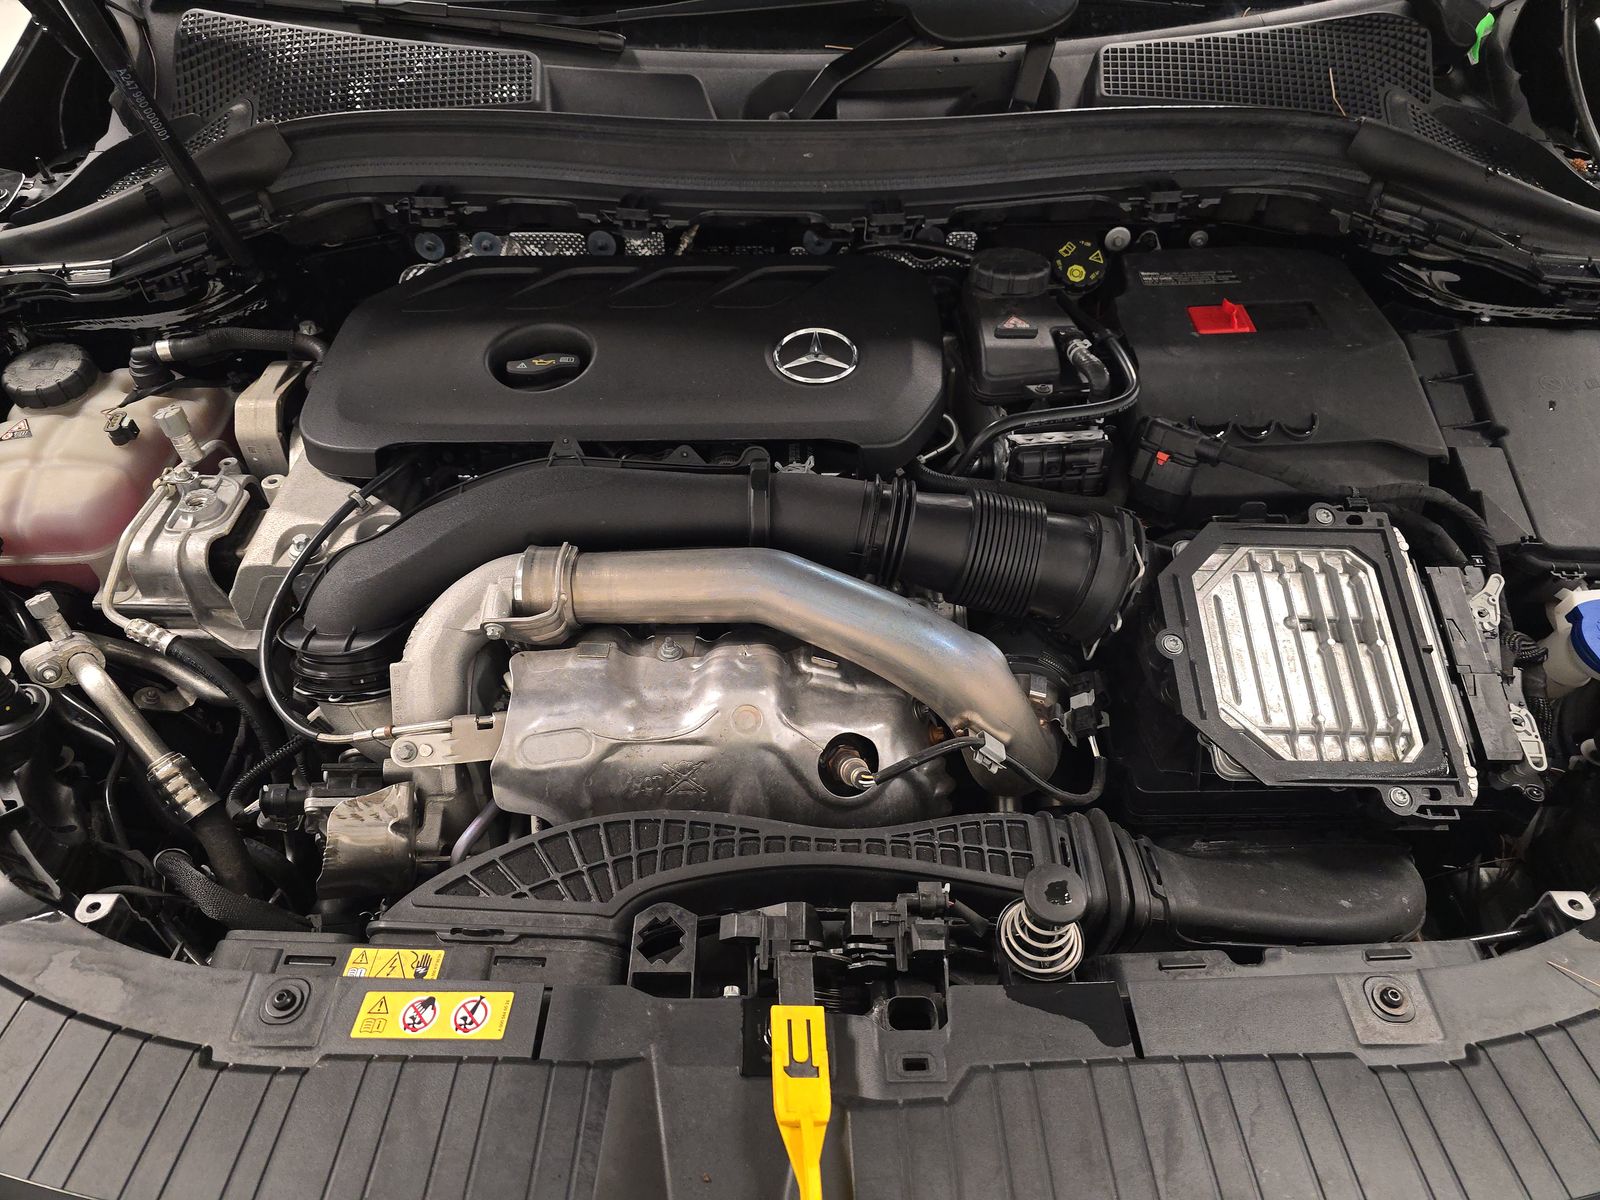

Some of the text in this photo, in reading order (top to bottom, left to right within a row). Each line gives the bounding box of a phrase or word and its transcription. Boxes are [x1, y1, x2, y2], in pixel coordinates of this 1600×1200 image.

[117, 68, 170, 141] A247 980 0000/01
